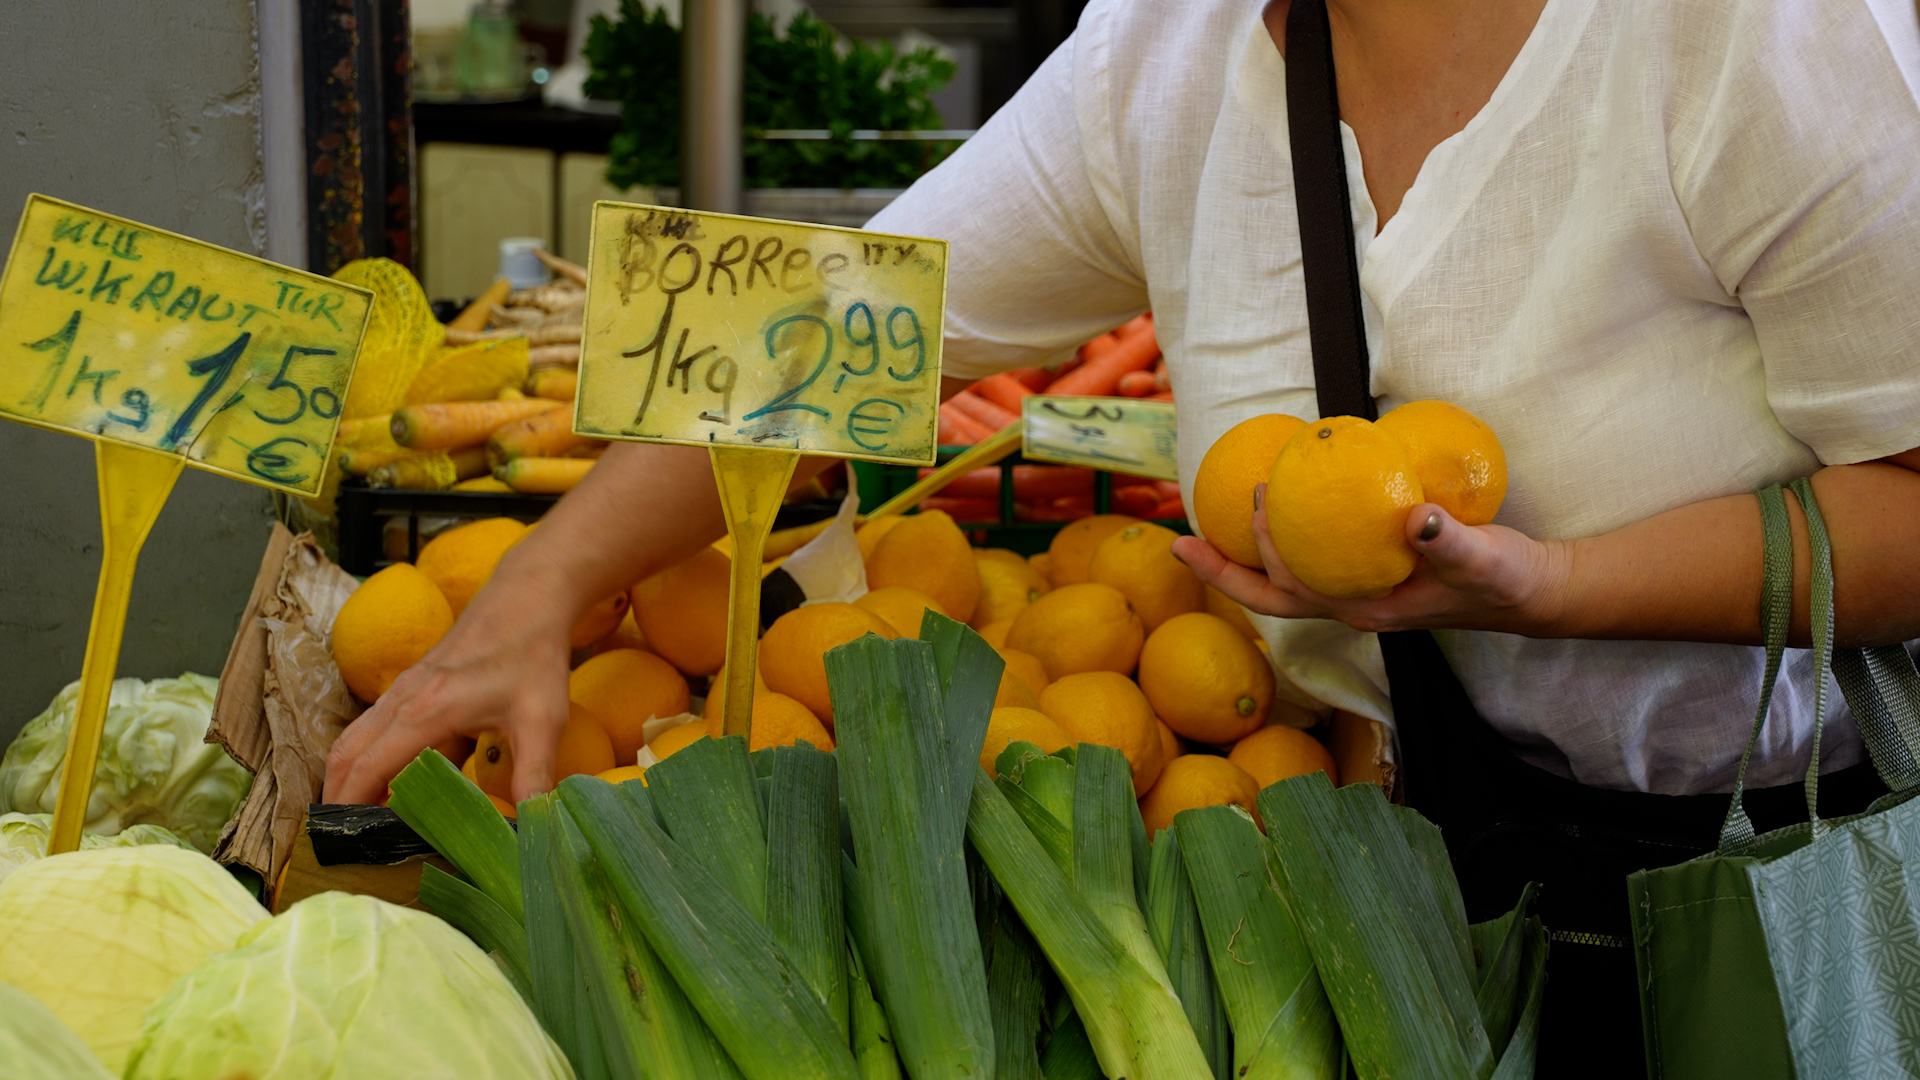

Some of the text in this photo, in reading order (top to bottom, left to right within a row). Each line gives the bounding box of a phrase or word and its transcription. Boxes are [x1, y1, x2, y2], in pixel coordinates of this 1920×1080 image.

[742, 301, 926, 423] 2,99
[847, 398, 905, 451] €
[246, 437, 310, 484] €
